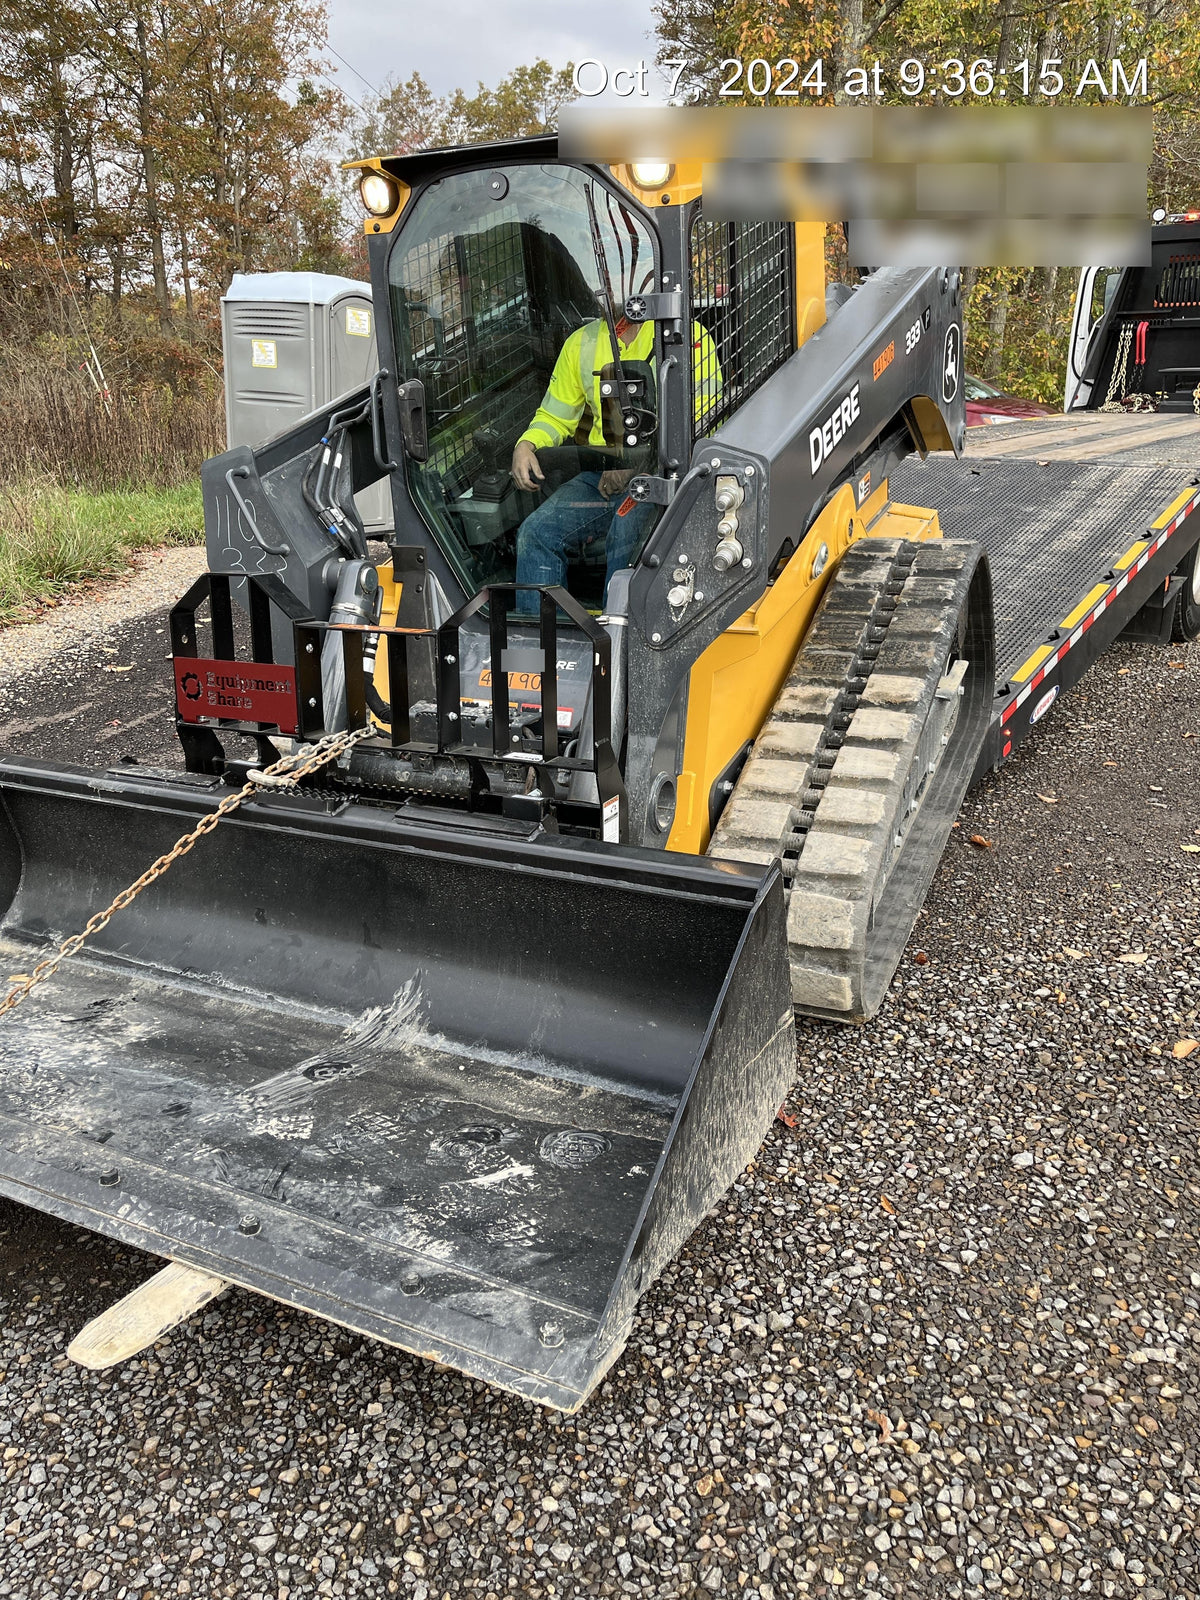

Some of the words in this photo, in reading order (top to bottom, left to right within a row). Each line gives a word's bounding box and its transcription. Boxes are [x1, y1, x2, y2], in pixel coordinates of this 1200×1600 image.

[905, 319, 921, 355] 333
[809, 383, 860, 476] DEERE
[206, 671, 292, 694] Equipment
[207, 690, 253, 709] Share
